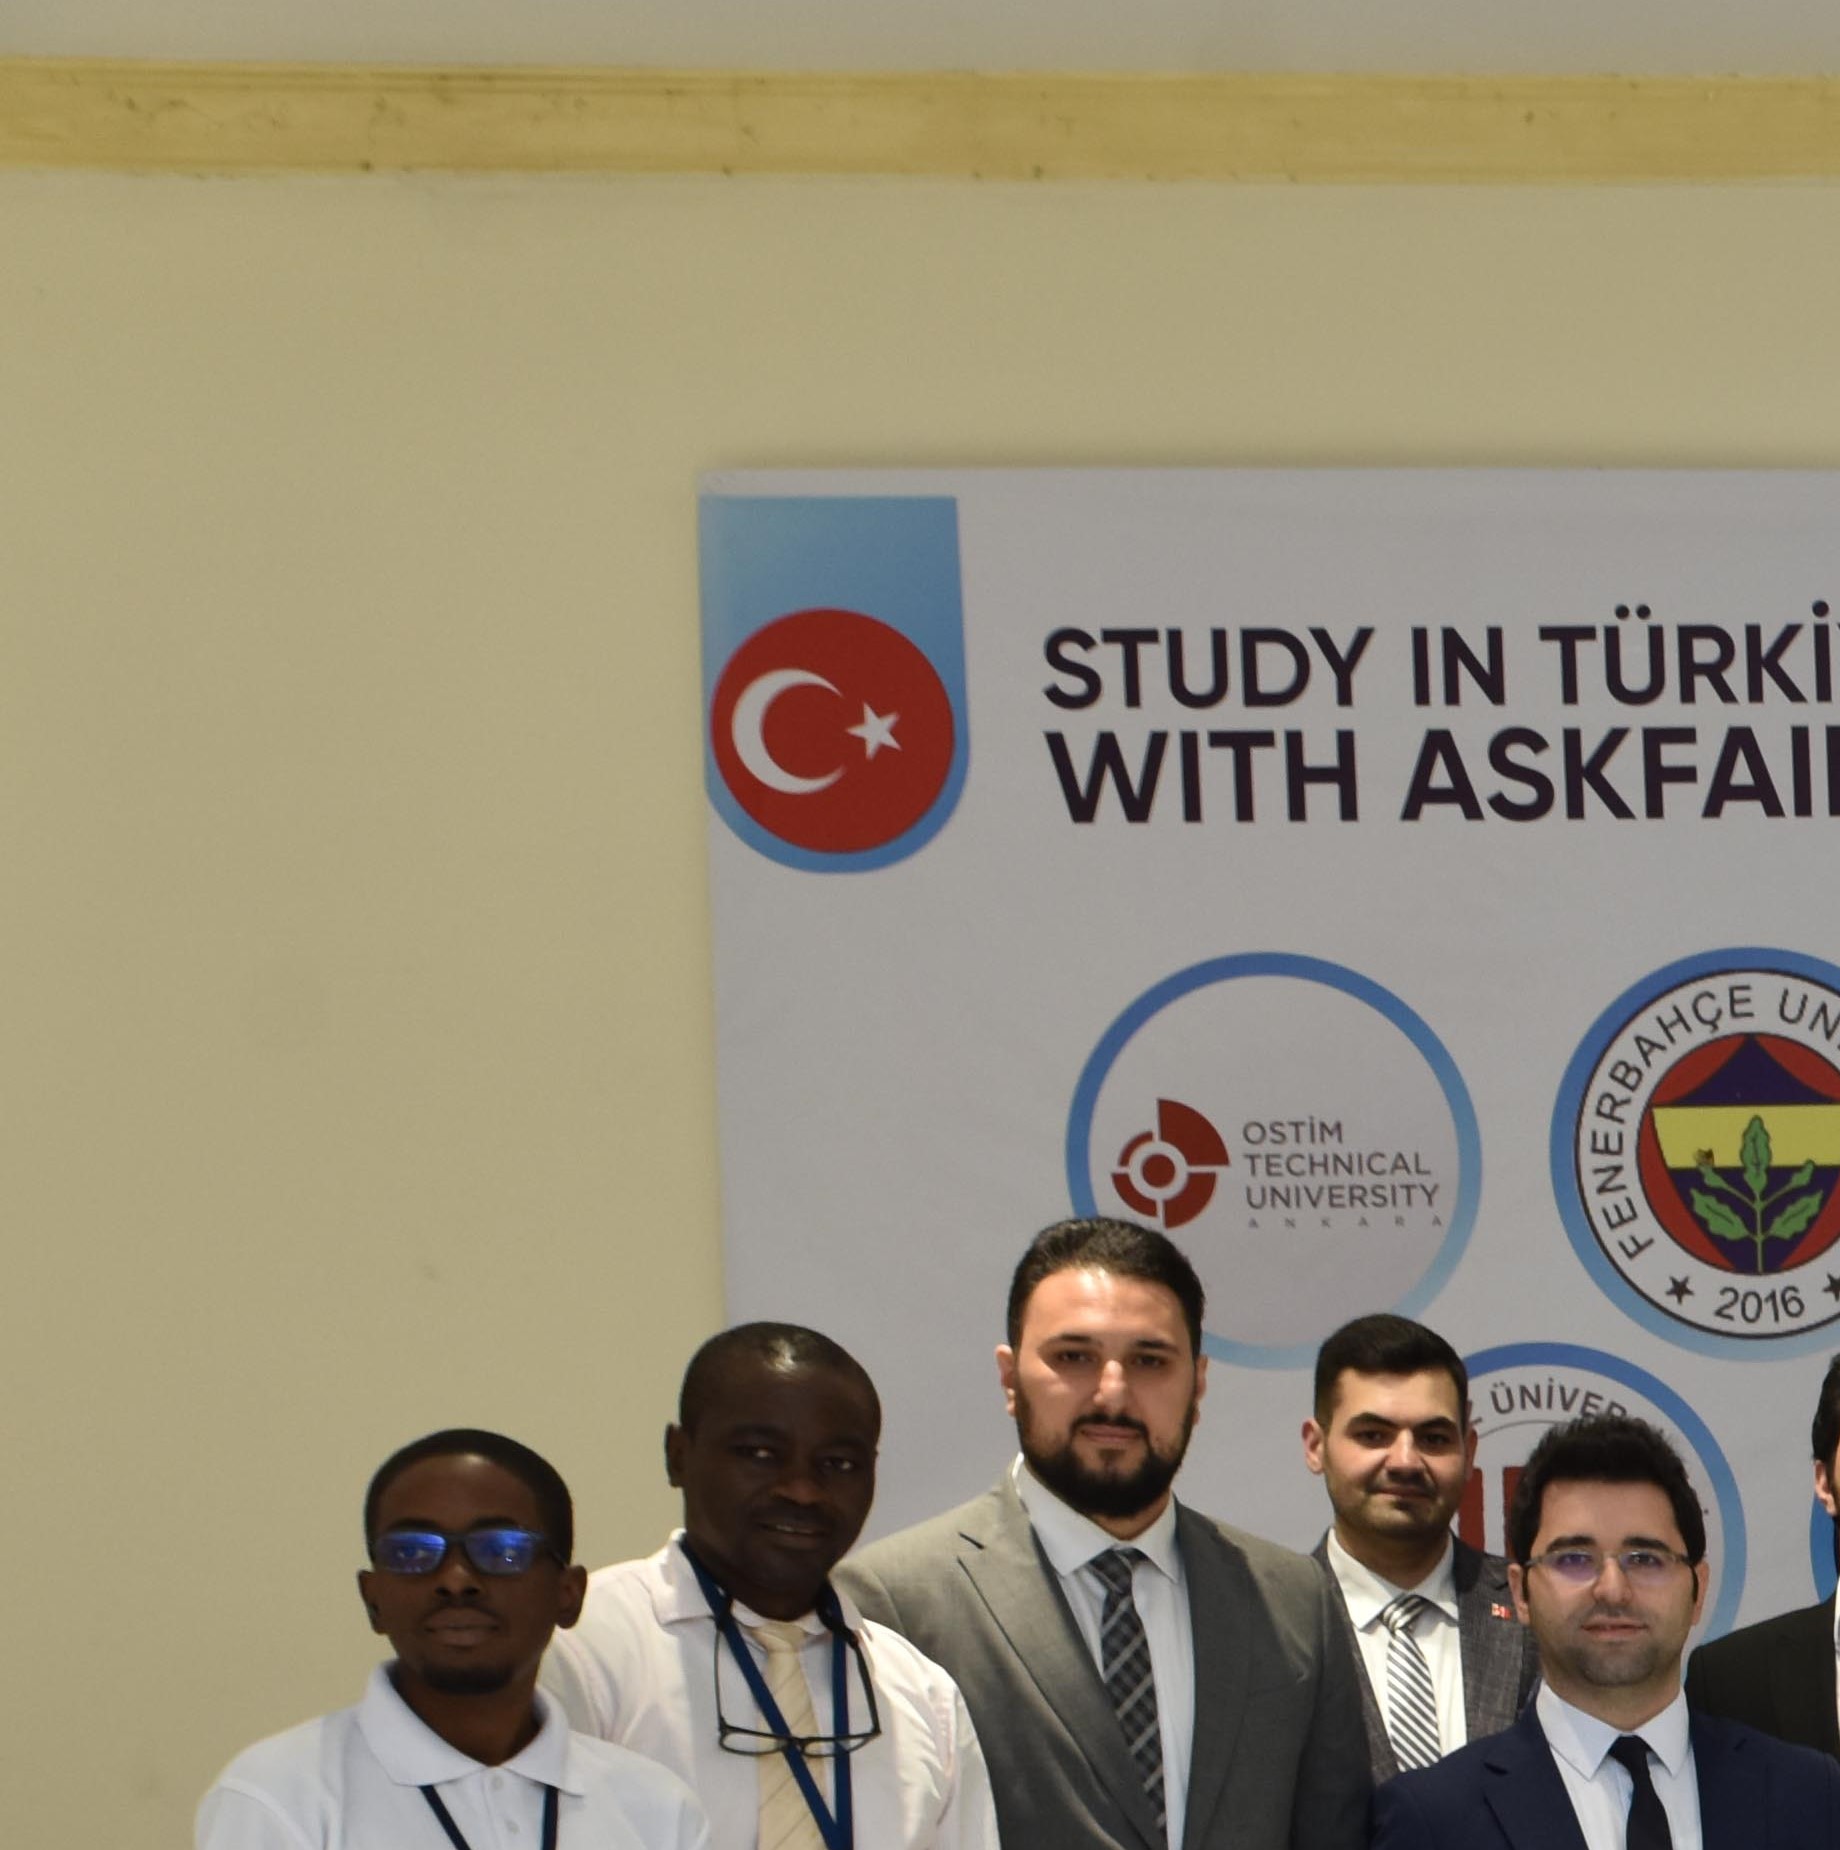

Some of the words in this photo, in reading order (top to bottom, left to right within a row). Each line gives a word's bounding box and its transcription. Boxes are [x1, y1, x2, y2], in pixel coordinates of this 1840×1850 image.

[1042, 624, 1375, 710] STUDY
[1411, 623, 1506, 708] IN
[1044, 729, 1360, 823] WITH
[1242, 1116, 1343, 1145] OSTİM
[1592, 985, 1755, 1260] FENERBAHÇE
[1243, 1152, 1432, 1177] TECHNICAL
[1245, 1183, 1440, 1210] UNIVERSITY
[1247, 1216, 1443, 1229] ANKARA
[1714, 1285, 1805, 1324] 2016
